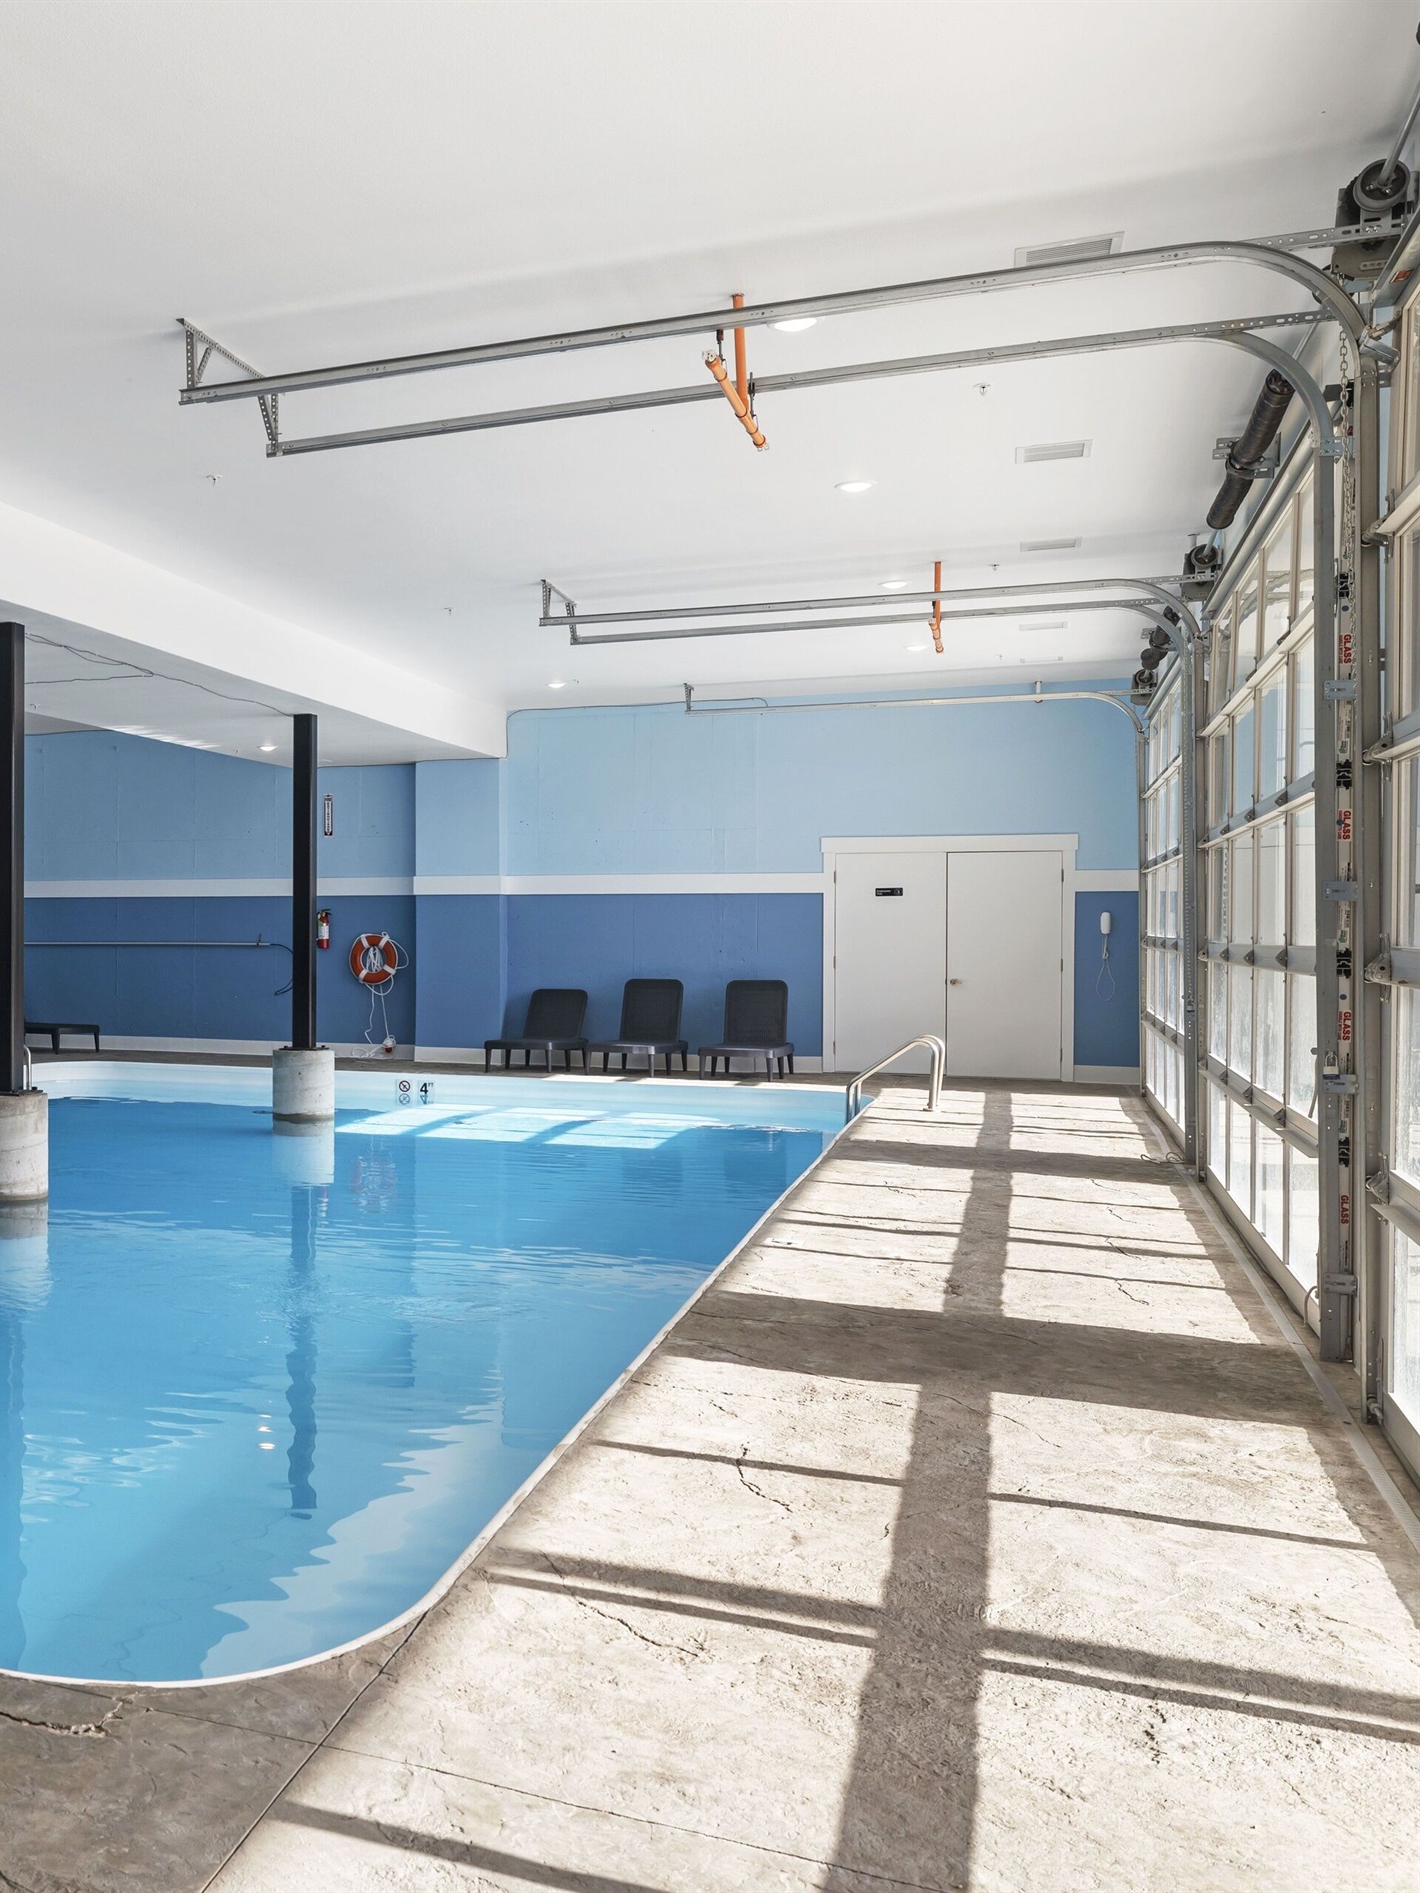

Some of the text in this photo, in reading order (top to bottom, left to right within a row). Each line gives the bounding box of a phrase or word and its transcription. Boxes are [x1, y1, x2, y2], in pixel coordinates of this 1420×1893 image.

[1344, 634, 1352, 664] GLASS
[1343, 810, 1351, 840] GLASS
[1343, 1012, 1351, 1041] GLASS
[420, 1083, 428, 1094] 4
[1341, 1195, 1349, 1224] GLASS
